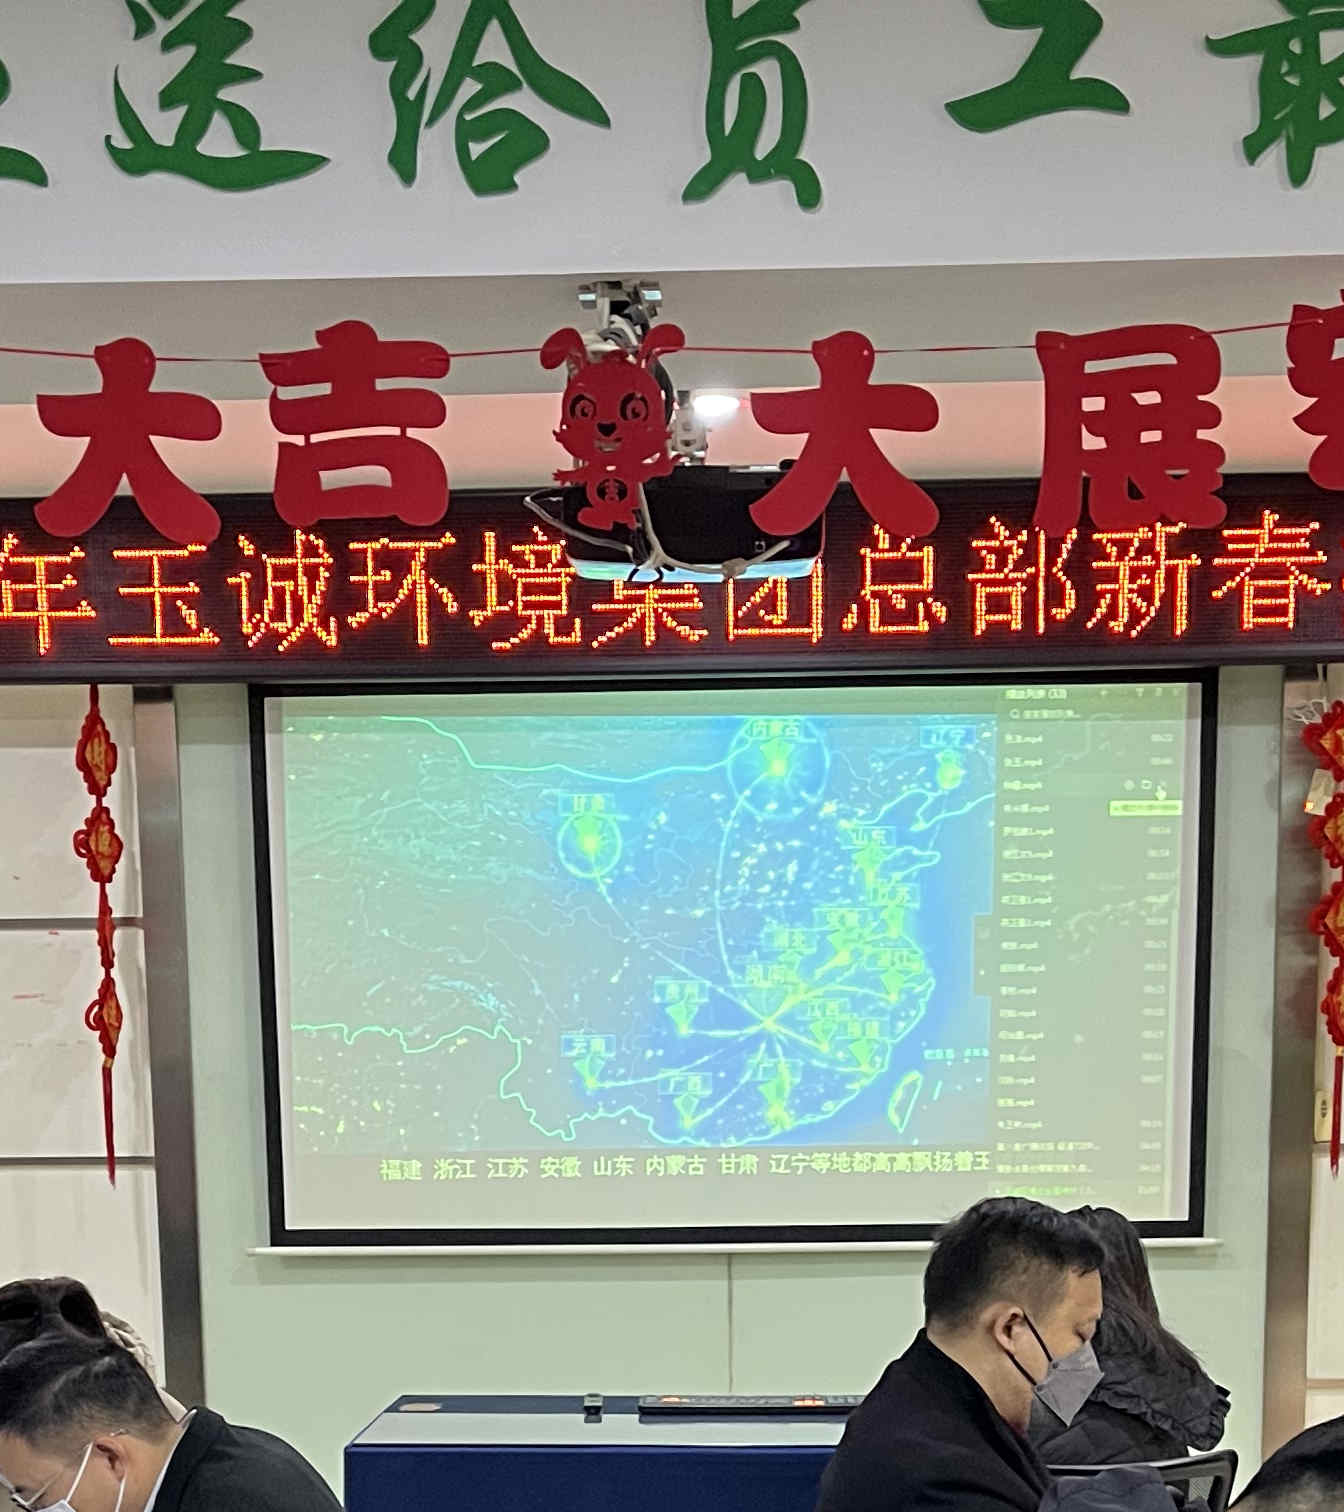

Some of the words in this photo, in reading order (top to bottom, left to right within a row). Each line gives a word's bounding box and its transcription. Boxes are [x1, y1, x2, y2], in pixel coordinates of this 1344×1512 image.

[380, 1160, 423, 1182] 福建
[433, 1159, 476, 1180] 浙江
[487, 1158, 529, 1179] 江苏
[540, 1157, 582, 1179] 安徽
[593, 1155, 635, 1177] 山东
[645, 1154, 707, 1177] 内蒙古
[717, 1153, 758, 1175] 甘肃
